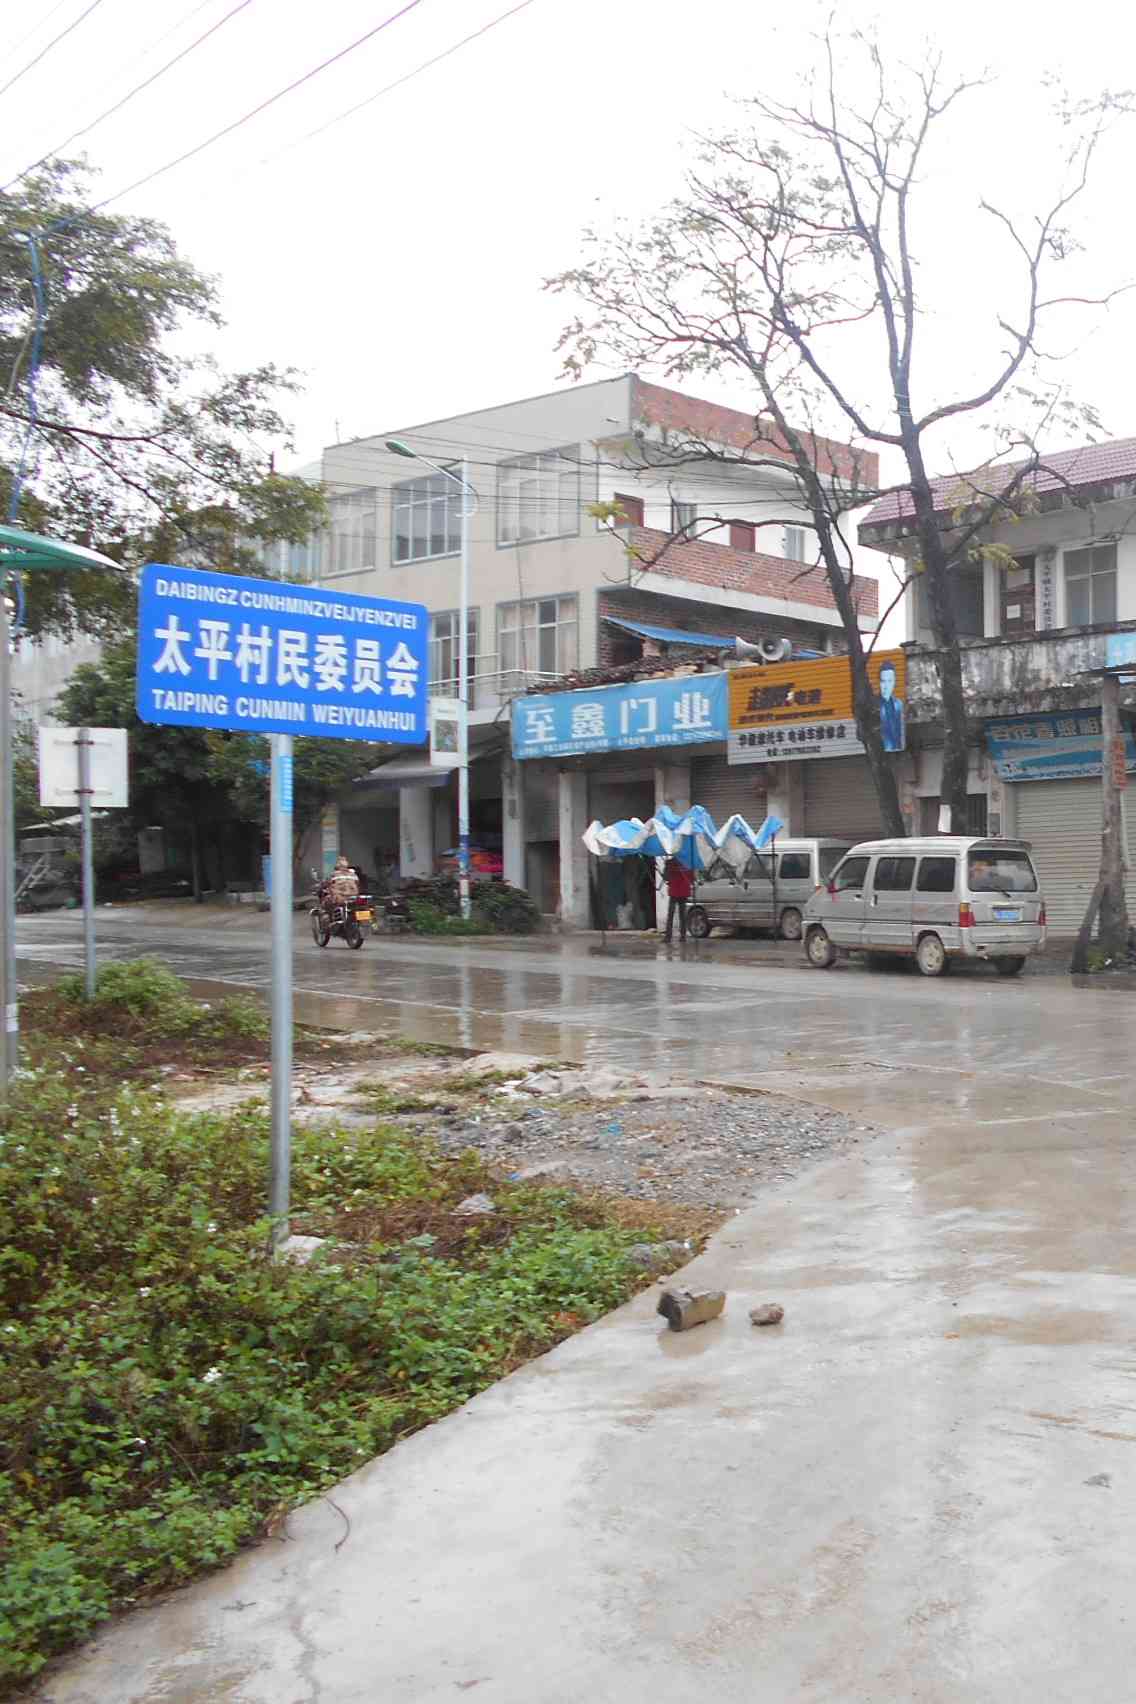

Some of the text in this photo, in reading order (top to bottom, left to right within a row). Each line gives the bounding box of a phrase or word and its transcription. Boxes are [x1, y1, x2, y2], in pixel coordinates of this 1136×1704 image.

[155, 579, 239, 605] DAIBINGZ
[152, 614, 420, 699] 太平村民委员会
[152, 689, 417, 732] TAIPING CUNMIN WEIYUANHUI
[524, 691, 712, 744] 至鑫门业
